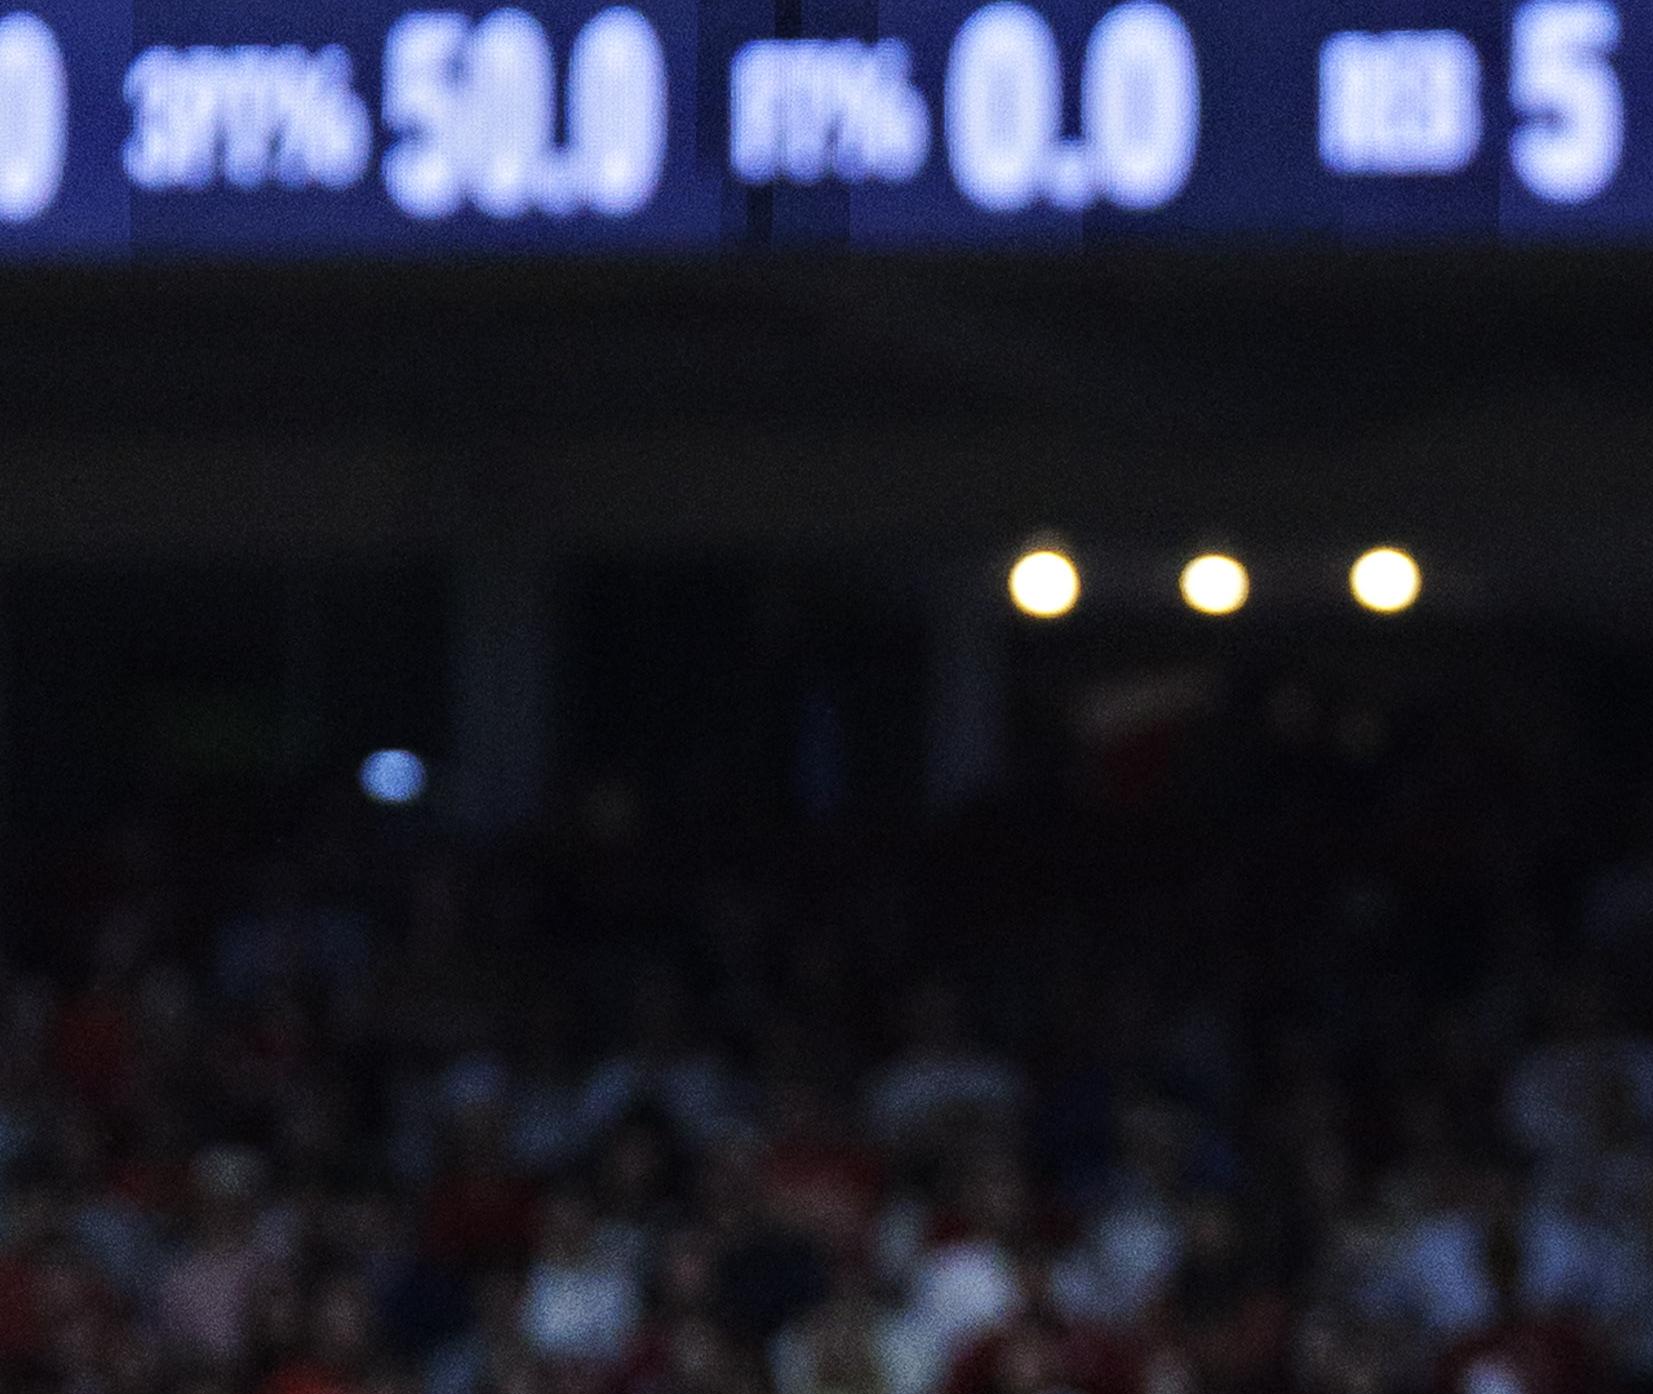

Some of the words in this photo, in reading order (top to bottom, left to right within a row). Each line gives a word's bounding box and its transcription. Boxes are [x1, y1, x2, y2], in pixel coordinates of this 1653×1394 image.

[382, 7, 667, 219] 50.0
[731, 39, 930, 180] FT%
[945, 0, 1200, 211] 0.0
[1319, 30, 1481, 173] REB
[1509, 0, 1624, 203] 5
